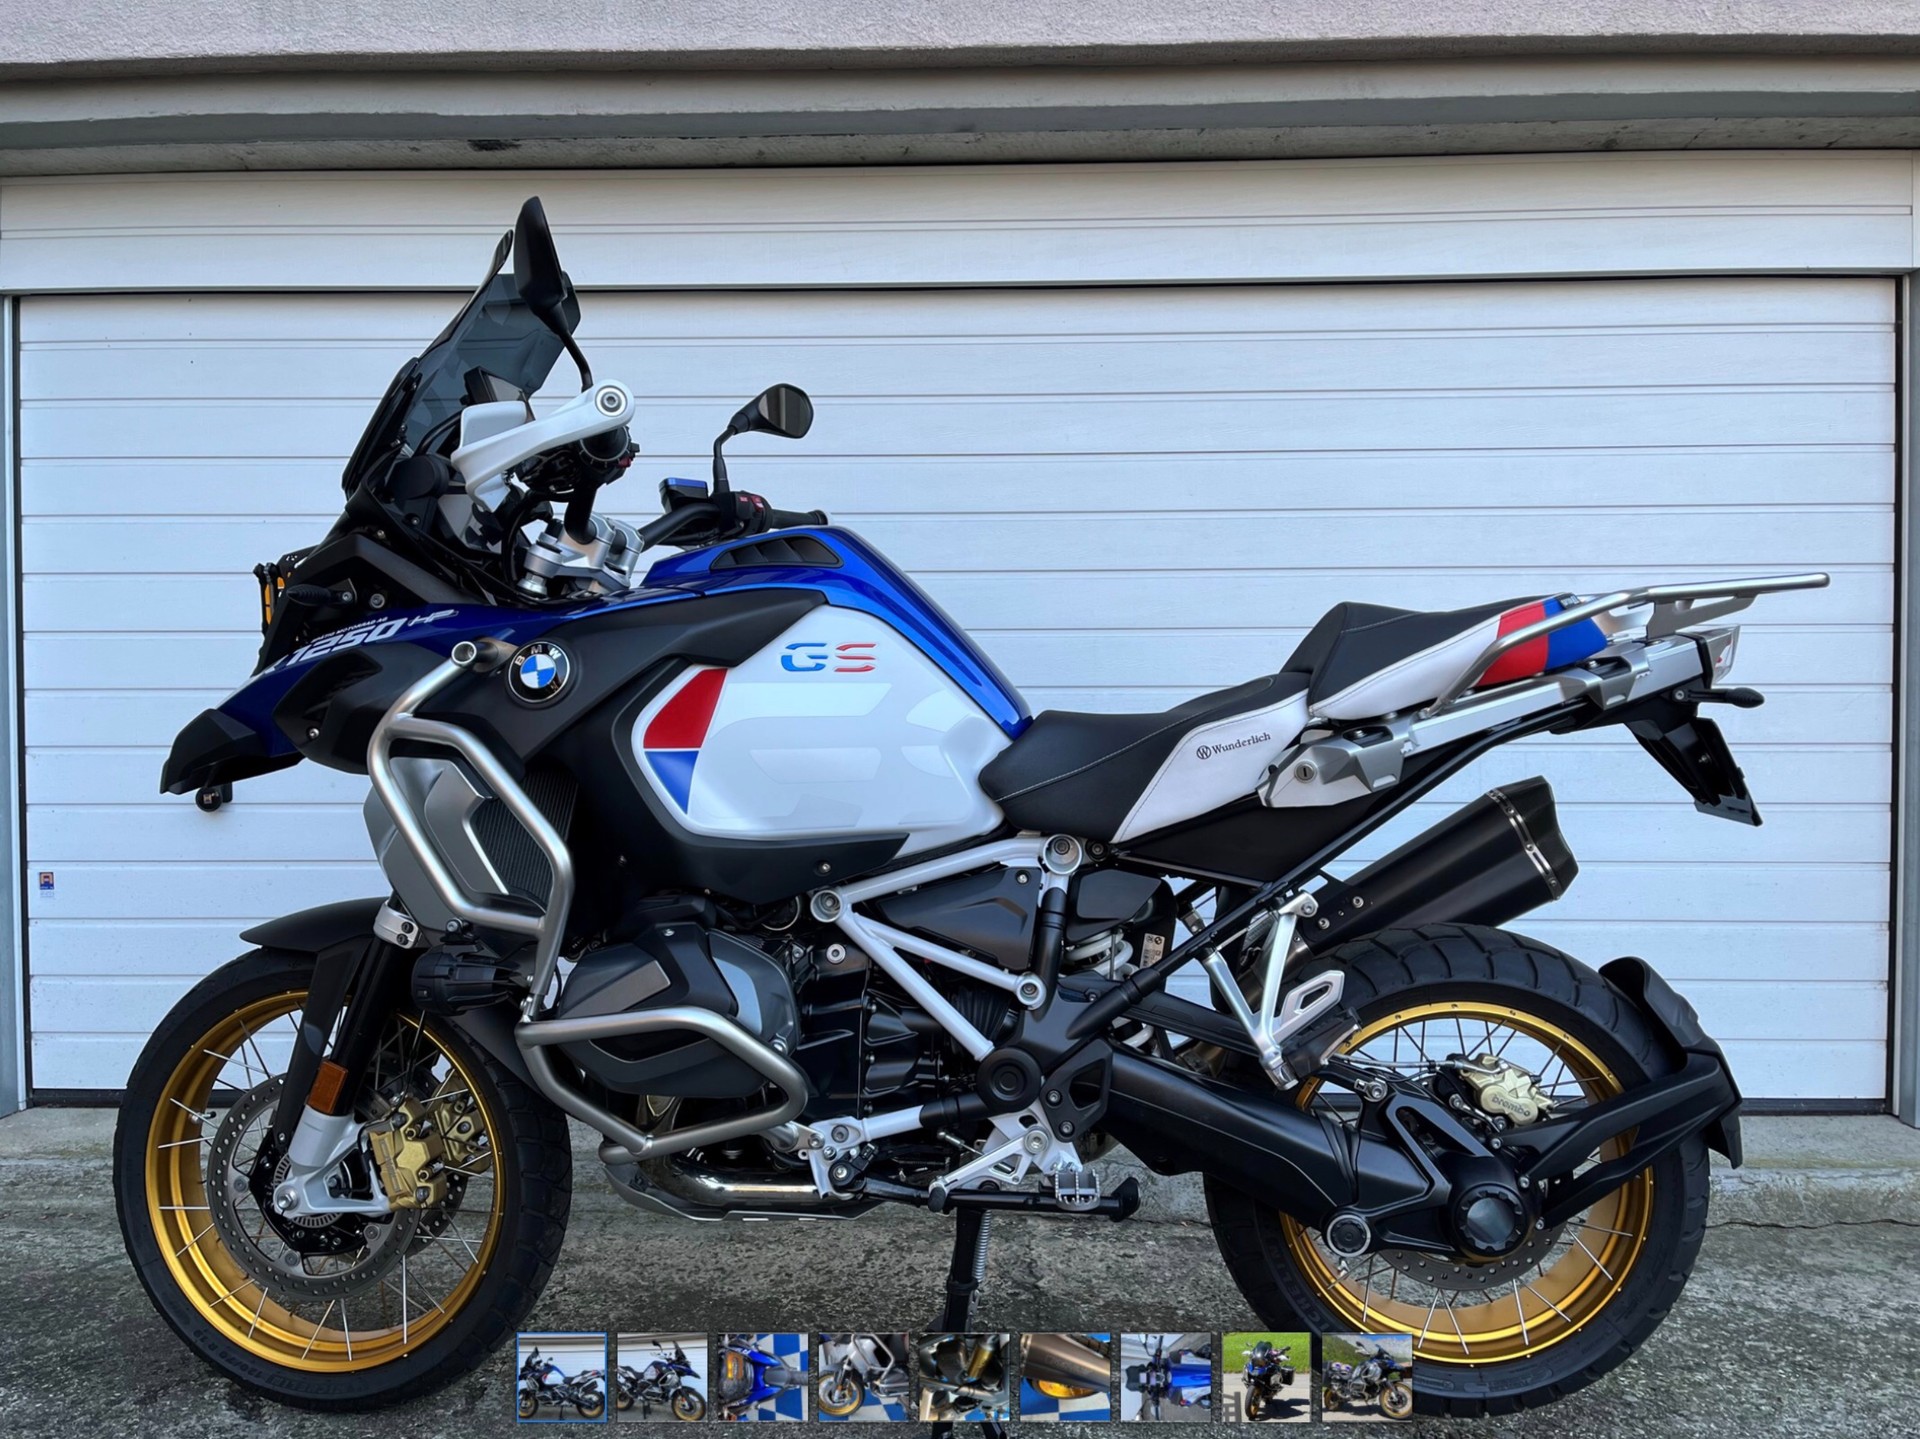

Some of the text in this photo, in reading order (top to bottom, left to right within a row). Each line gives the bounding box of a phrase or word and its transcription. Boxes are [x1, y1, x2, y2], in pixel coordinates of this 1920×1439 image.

[286, 618, 407, 666] 1250
[780, 643, 876, 672] GS
[1212, 732, 1271, 754] Wunderlich
[1491, 1095, 1531, 1117] brembo
[219, 1352, 263, 1379] 120/70
